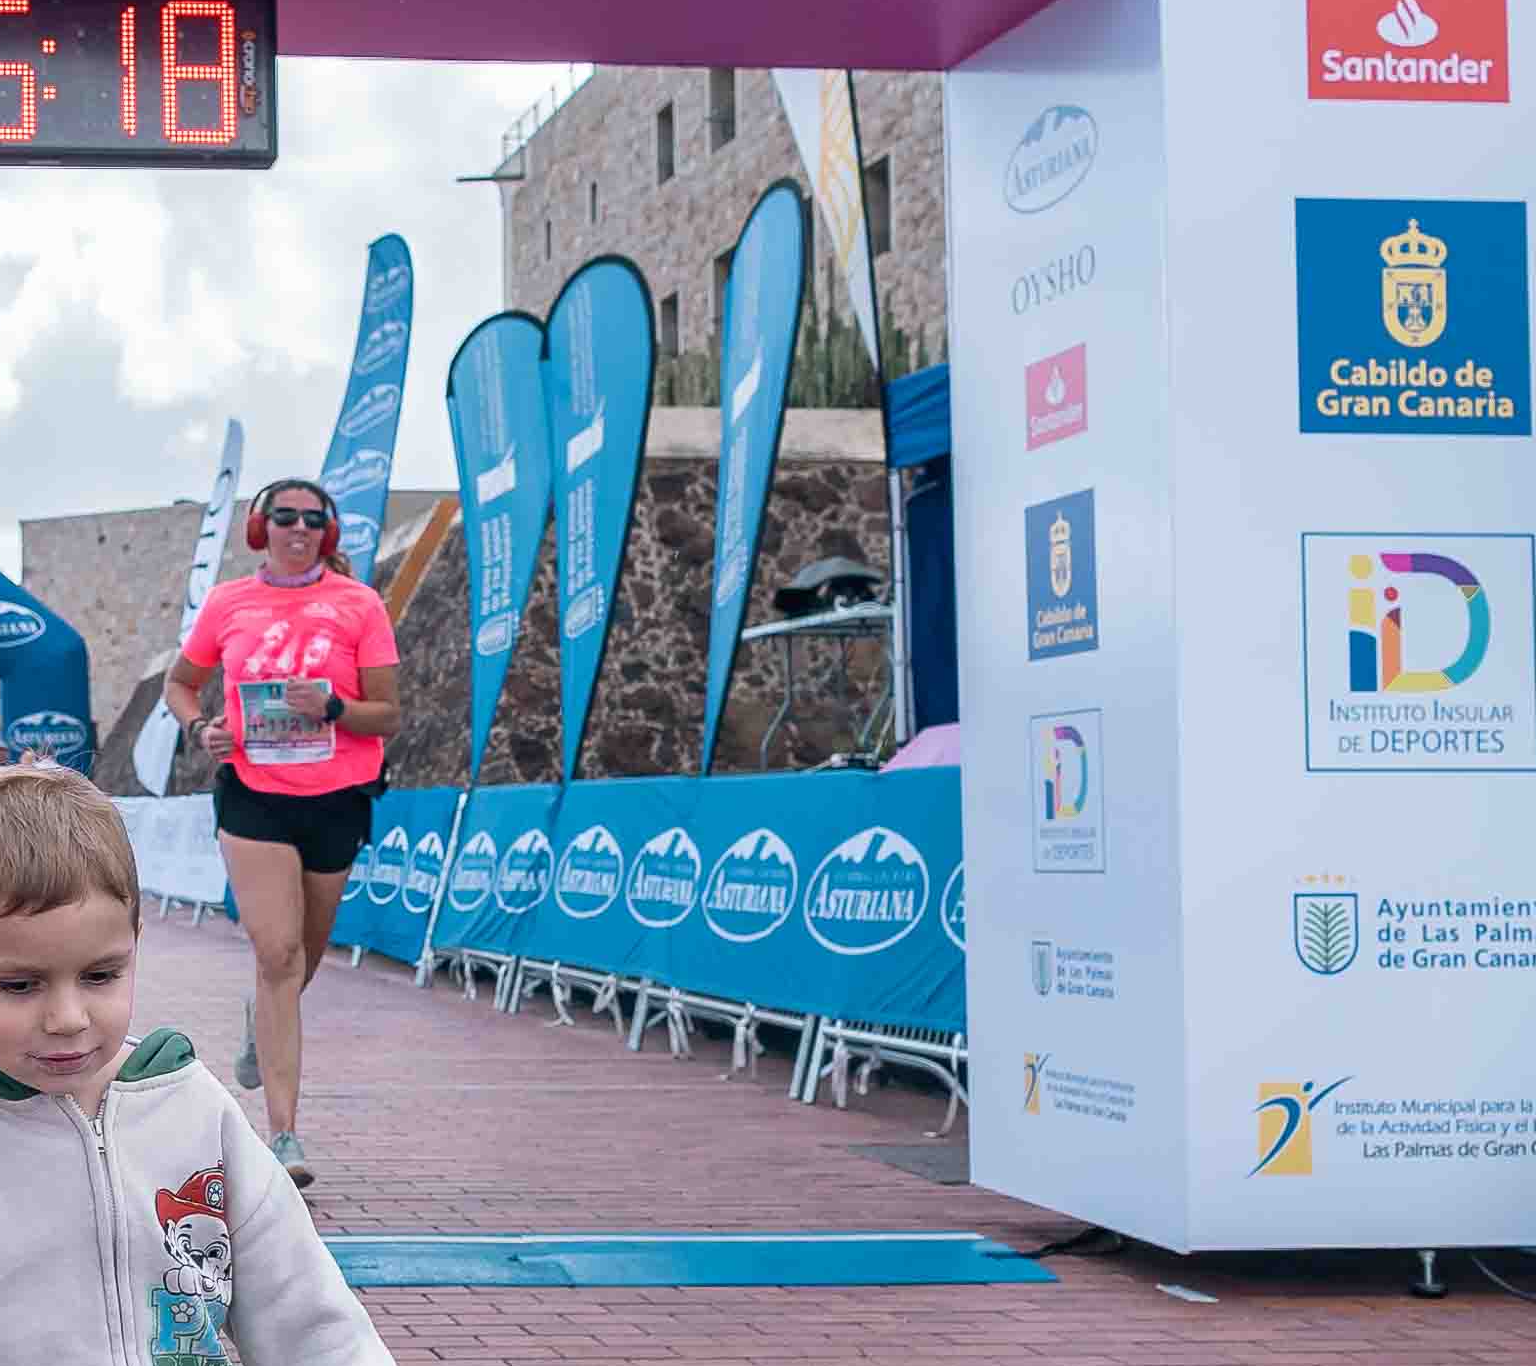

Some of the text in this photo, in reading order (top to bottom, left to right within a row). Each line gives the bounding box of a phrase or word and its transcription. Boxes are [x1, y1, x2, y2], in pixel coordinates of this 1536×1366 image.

[1322, 49, 1493, 86] Santander
[1011, 244, 1097, 317] OYSHO
[1329, 359, 1493, 389] Cabildo de
[1317, 388, 1514, 419] Gran Canaria
[1370, 729, 1505, 755] DEPORTES
[707, 868, 786, 914] ASTURIANA
[809, 873, 915, 922] ASTURIANA
[1377, 923, 1407, 944] de
[1422, 923, 1459, 944] Las
[1377, 948, 1407, 969] de
[1412, 948, 1466, 970] Gran
[1334, 1099, 1396, 1115] Instituto
[1400, 1098, 1476, 1118] Municipal
[1480, 1101, 1515, 1119] para
[1336, 1120, 1356, 1136] de
[1378, 1119, 1451, 1135] Actividad
[1362, 1141, 1390, 1158] Las
[1394, 1141, 1454, 1158] Palmas
[1457, 1142, 1479, 1157] de
[1484, 1140, 1528, 1157] Gran
